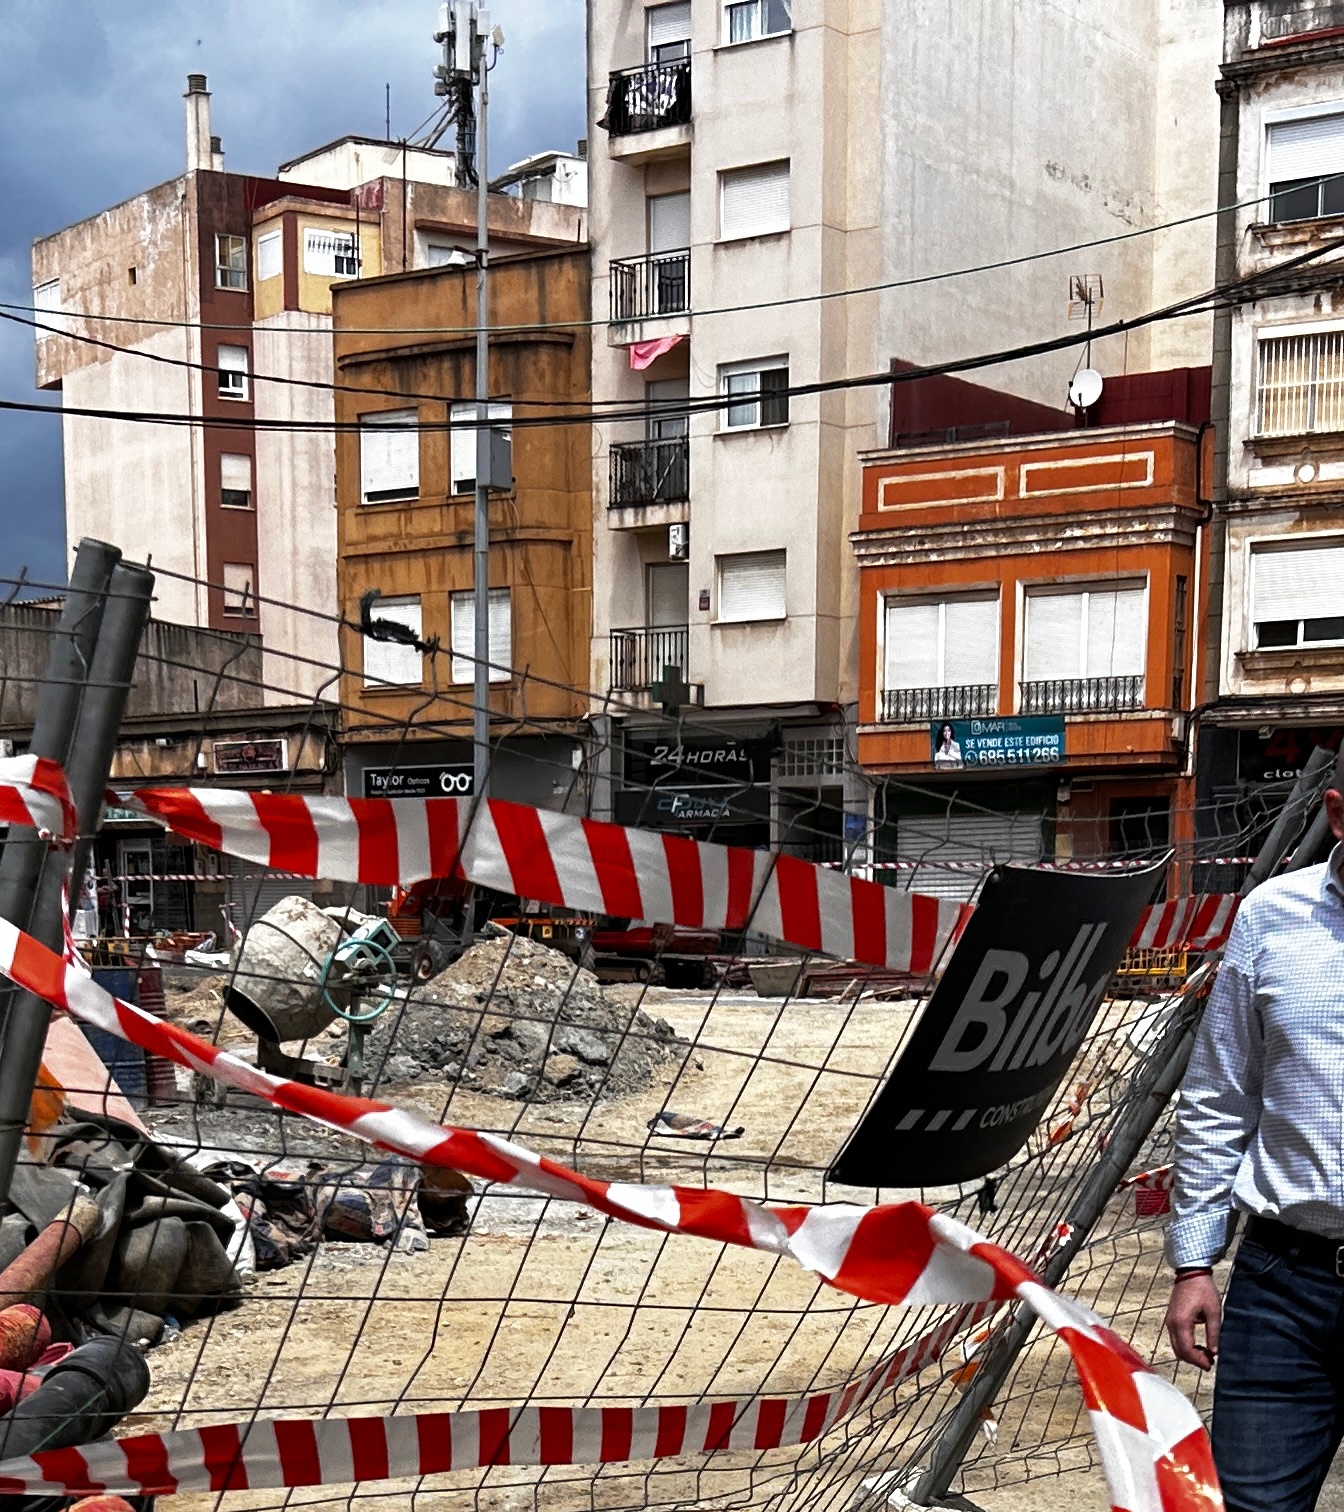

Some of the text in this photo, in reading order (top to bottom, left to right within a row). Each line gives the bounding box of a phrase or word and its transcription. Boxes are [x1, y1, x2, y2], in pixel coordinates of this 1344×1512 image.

[965, 734, 1060, 749] SE VENDE ESTE EDIFICIO
[650, 745, 685, 766] 24
[369, 773, 405, 790] Tayor
